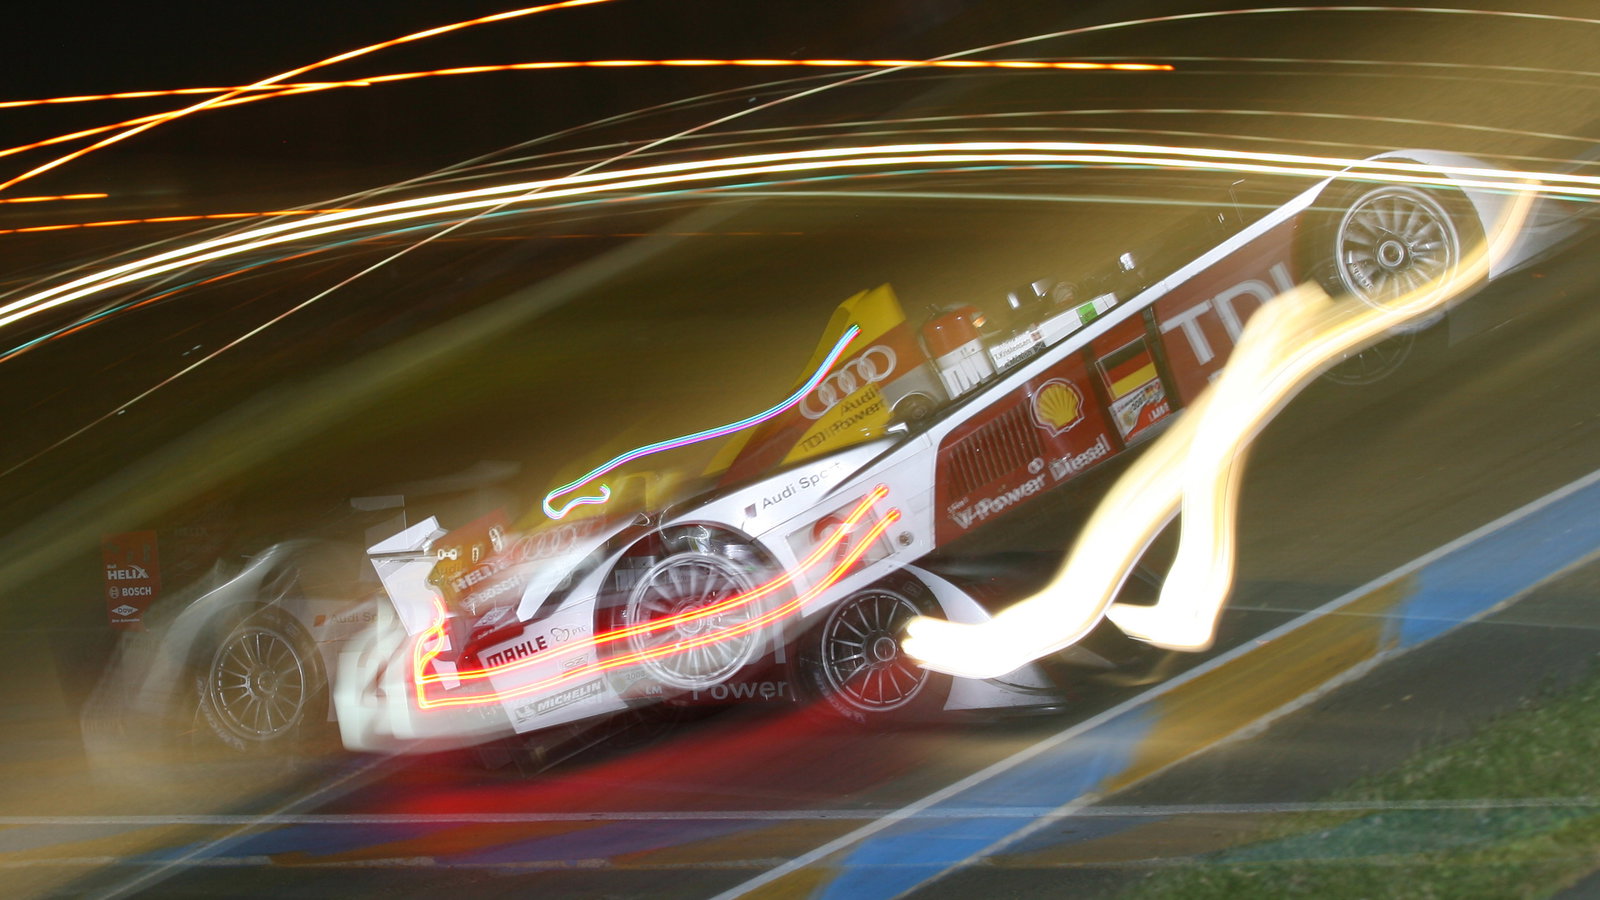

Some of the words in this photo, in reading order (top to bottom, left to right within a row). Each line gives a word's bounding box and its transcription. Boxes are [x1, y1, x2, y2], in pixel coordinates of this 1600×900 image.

[840, 384, 879, 417] Audi
[762, 483, 797, 510] Audi
[798, 461, 840, 489] Spot
[951, 473, 1047, 529] V-Power
[1049, 433, 1111, 482] Diesel
[107, 565, 149, 580] HELIX
[122, 586, 152, 597] BOSCH
[486, 635, 548, 668] MAHLE
[537, 681, 602, 712] MICHELIN
